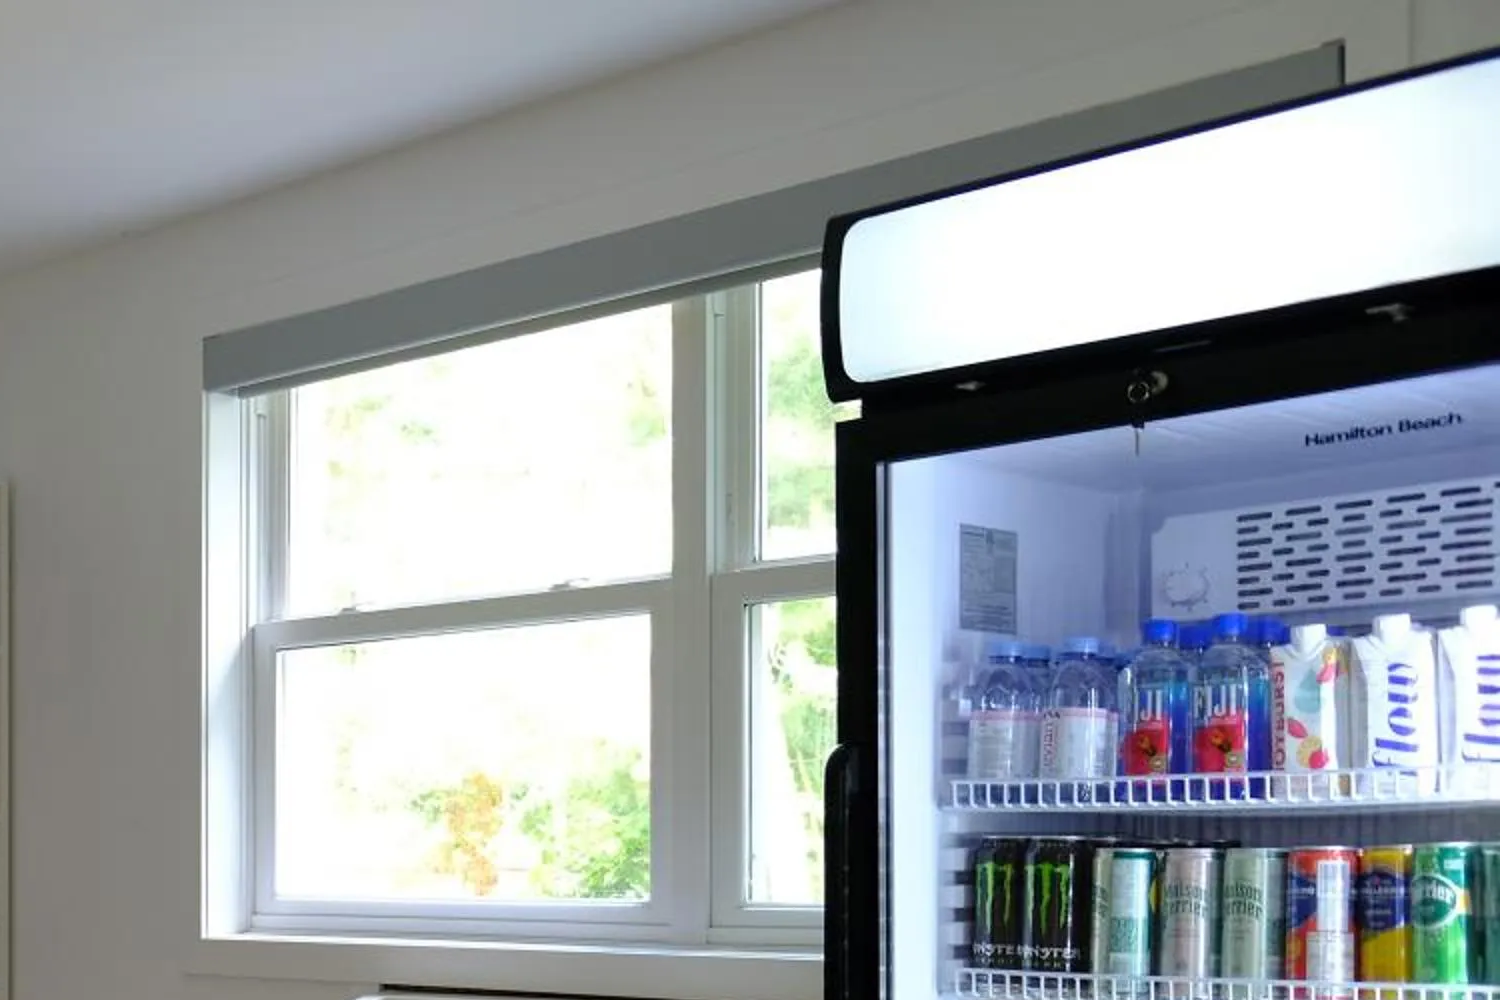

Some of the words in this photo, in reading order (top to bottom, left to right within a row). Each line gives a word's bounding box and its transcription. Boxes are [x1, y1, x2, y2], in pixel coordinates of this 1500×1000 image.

[1305, 425, 1393, 447] Hamilton
[1398, 412, 1462, 433] Beach
[1372, 663, 1419, 776] flow
